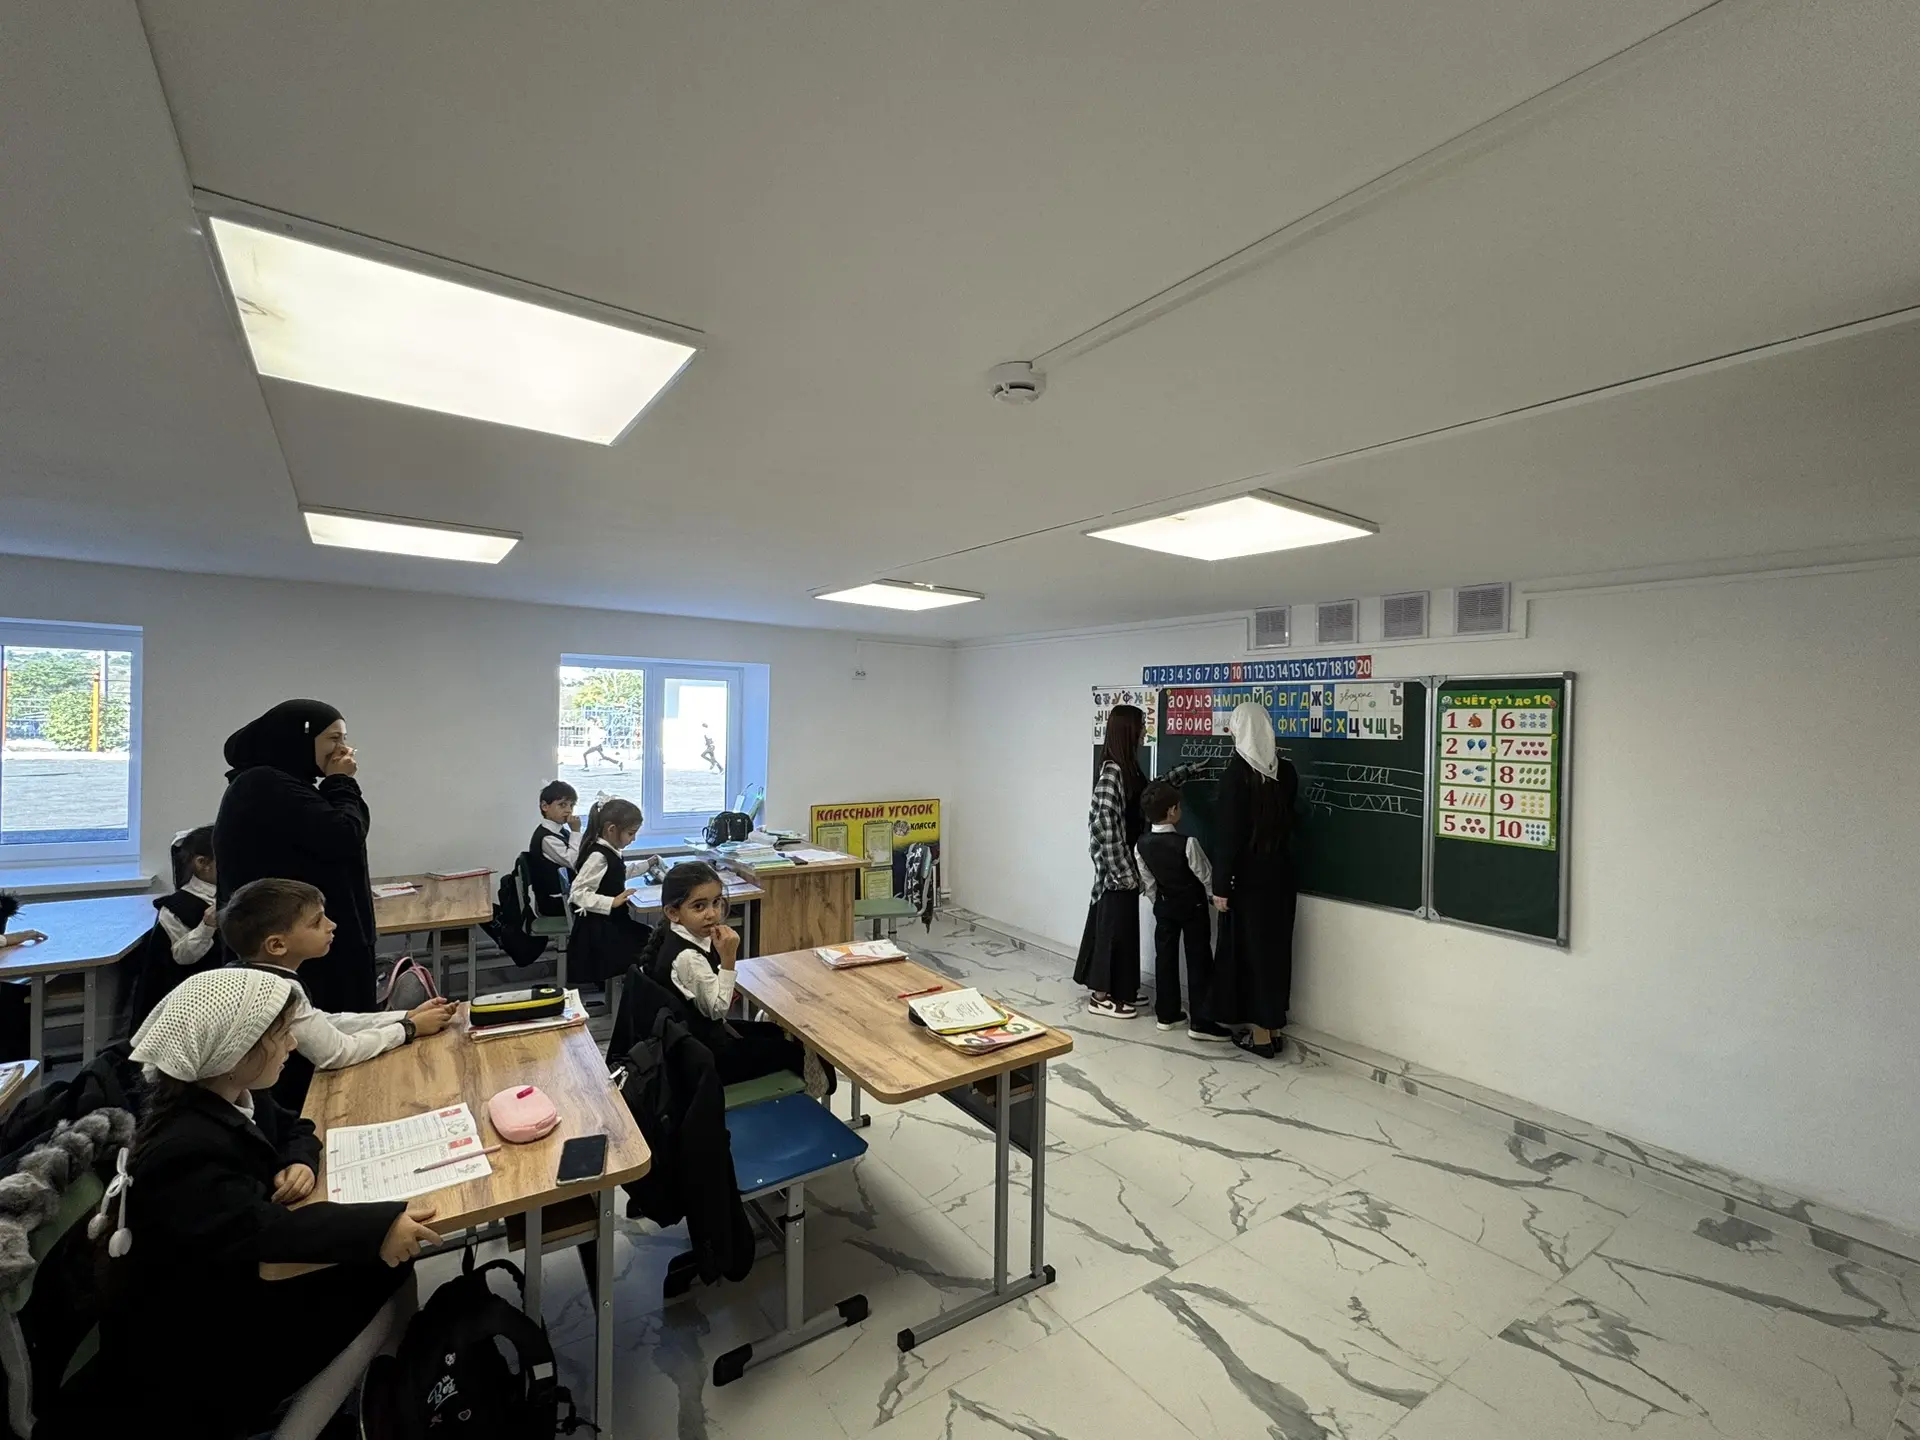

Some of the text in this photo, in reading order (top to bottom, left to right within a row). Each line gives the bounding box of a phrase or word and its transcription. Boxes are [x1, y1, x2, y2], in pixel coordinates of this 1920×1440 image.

[1145, 660, 1370, 681] 0 1 2 3 4 5 6 7 8 9 10 11 12 13 14 15 16 17 18 19 20
[1454, 694, 1487, 705] СЧЁТ
[1506, 695, 1512, 705] 1
[1534, 694, 1552, 705] 10
[1447, 712, 1458, 728] 1
[1500, 712, 1515, 729] 6
[1446, 738, 1458, 754] 2
[1500, 739, 1514, 756] 7
[1445, 764, 1457, 780] 3
[1500, 766, 1514, 784] 8
[1444, 790, 1457, 806] 4
[1500, 794, 1514, 810] 9
[816, 804, 933, 820] КЛАССНЫЙ УГОЛОК
[1444, 814, 1456, 832] 5
[1497, 820, 1522, 838] 10
